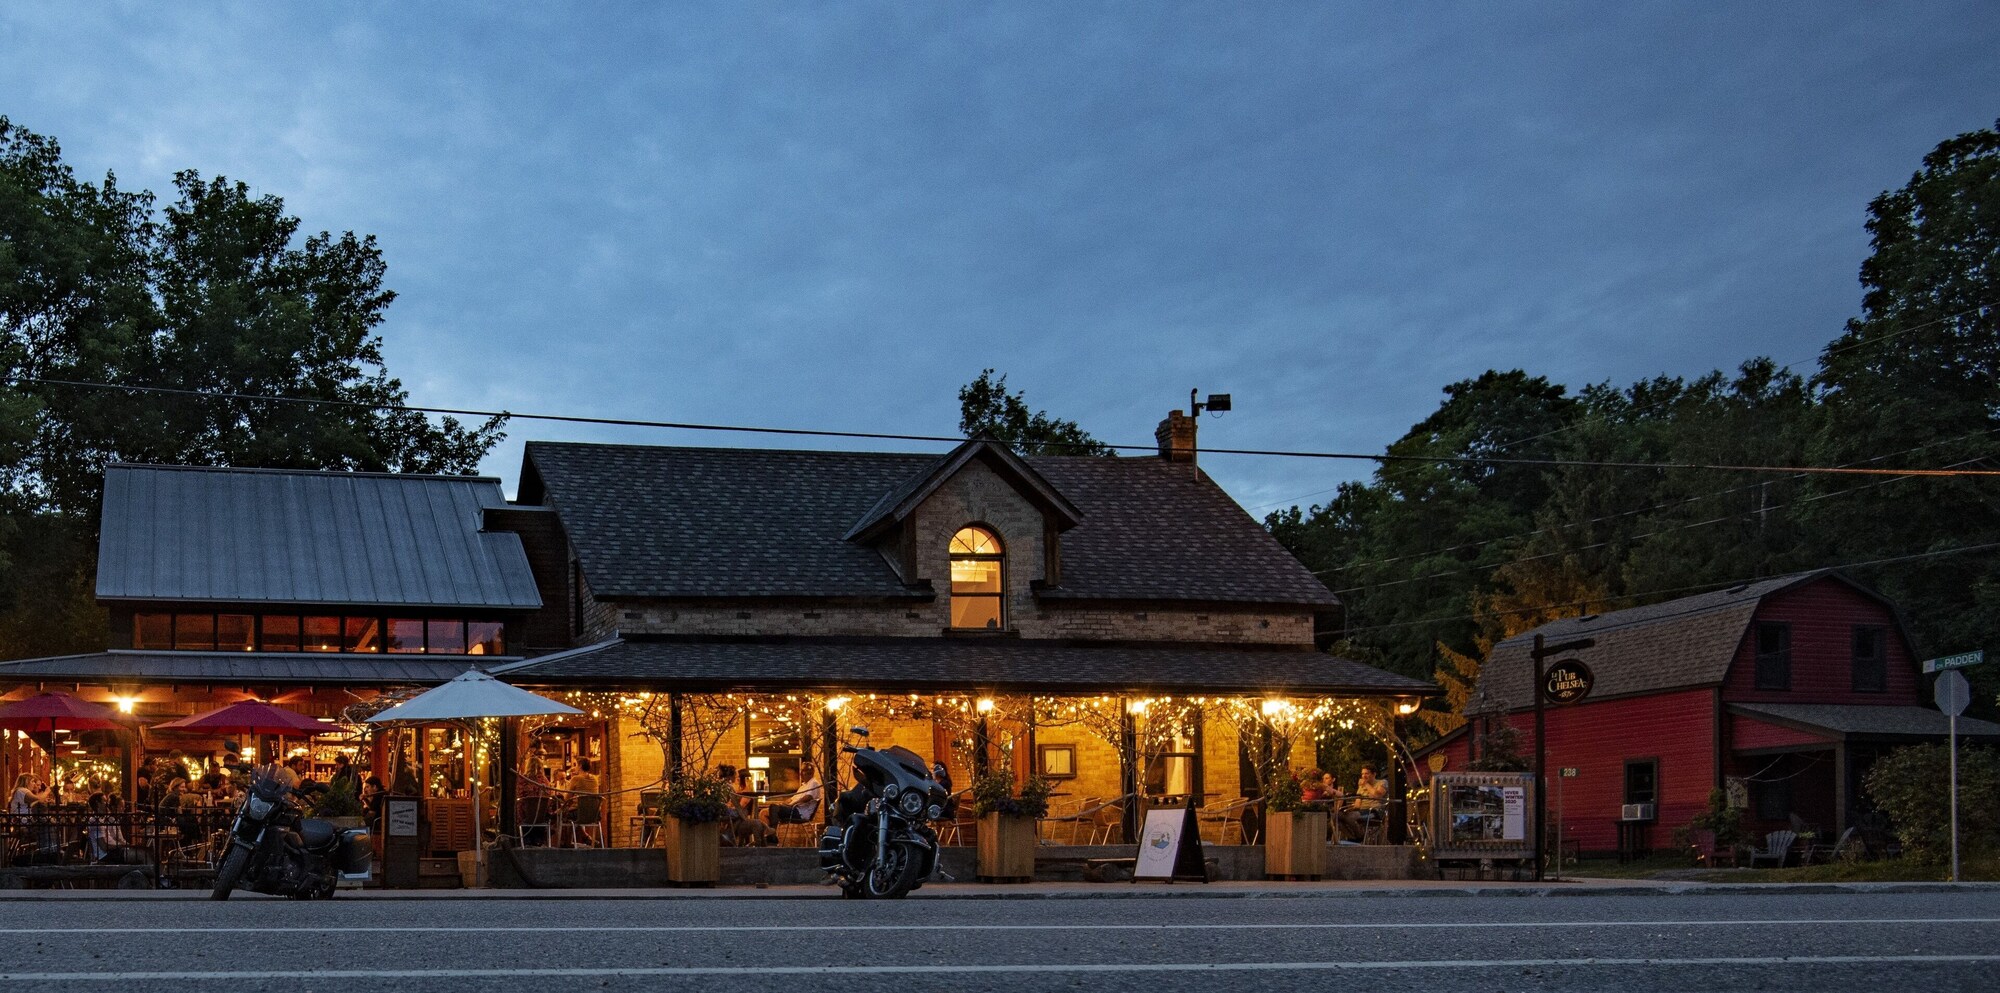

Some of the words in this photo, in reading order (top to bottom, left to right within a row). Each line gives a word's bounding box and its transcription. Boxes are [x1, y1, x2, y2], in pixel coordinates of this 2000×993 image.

[1944, 652, 1981, 668] PADDEN
[1557, 669, 1576, 682] PUB
[1548, 678, 1585, 693] CHELSEA
[1563, 768, 1576, 777] 238
